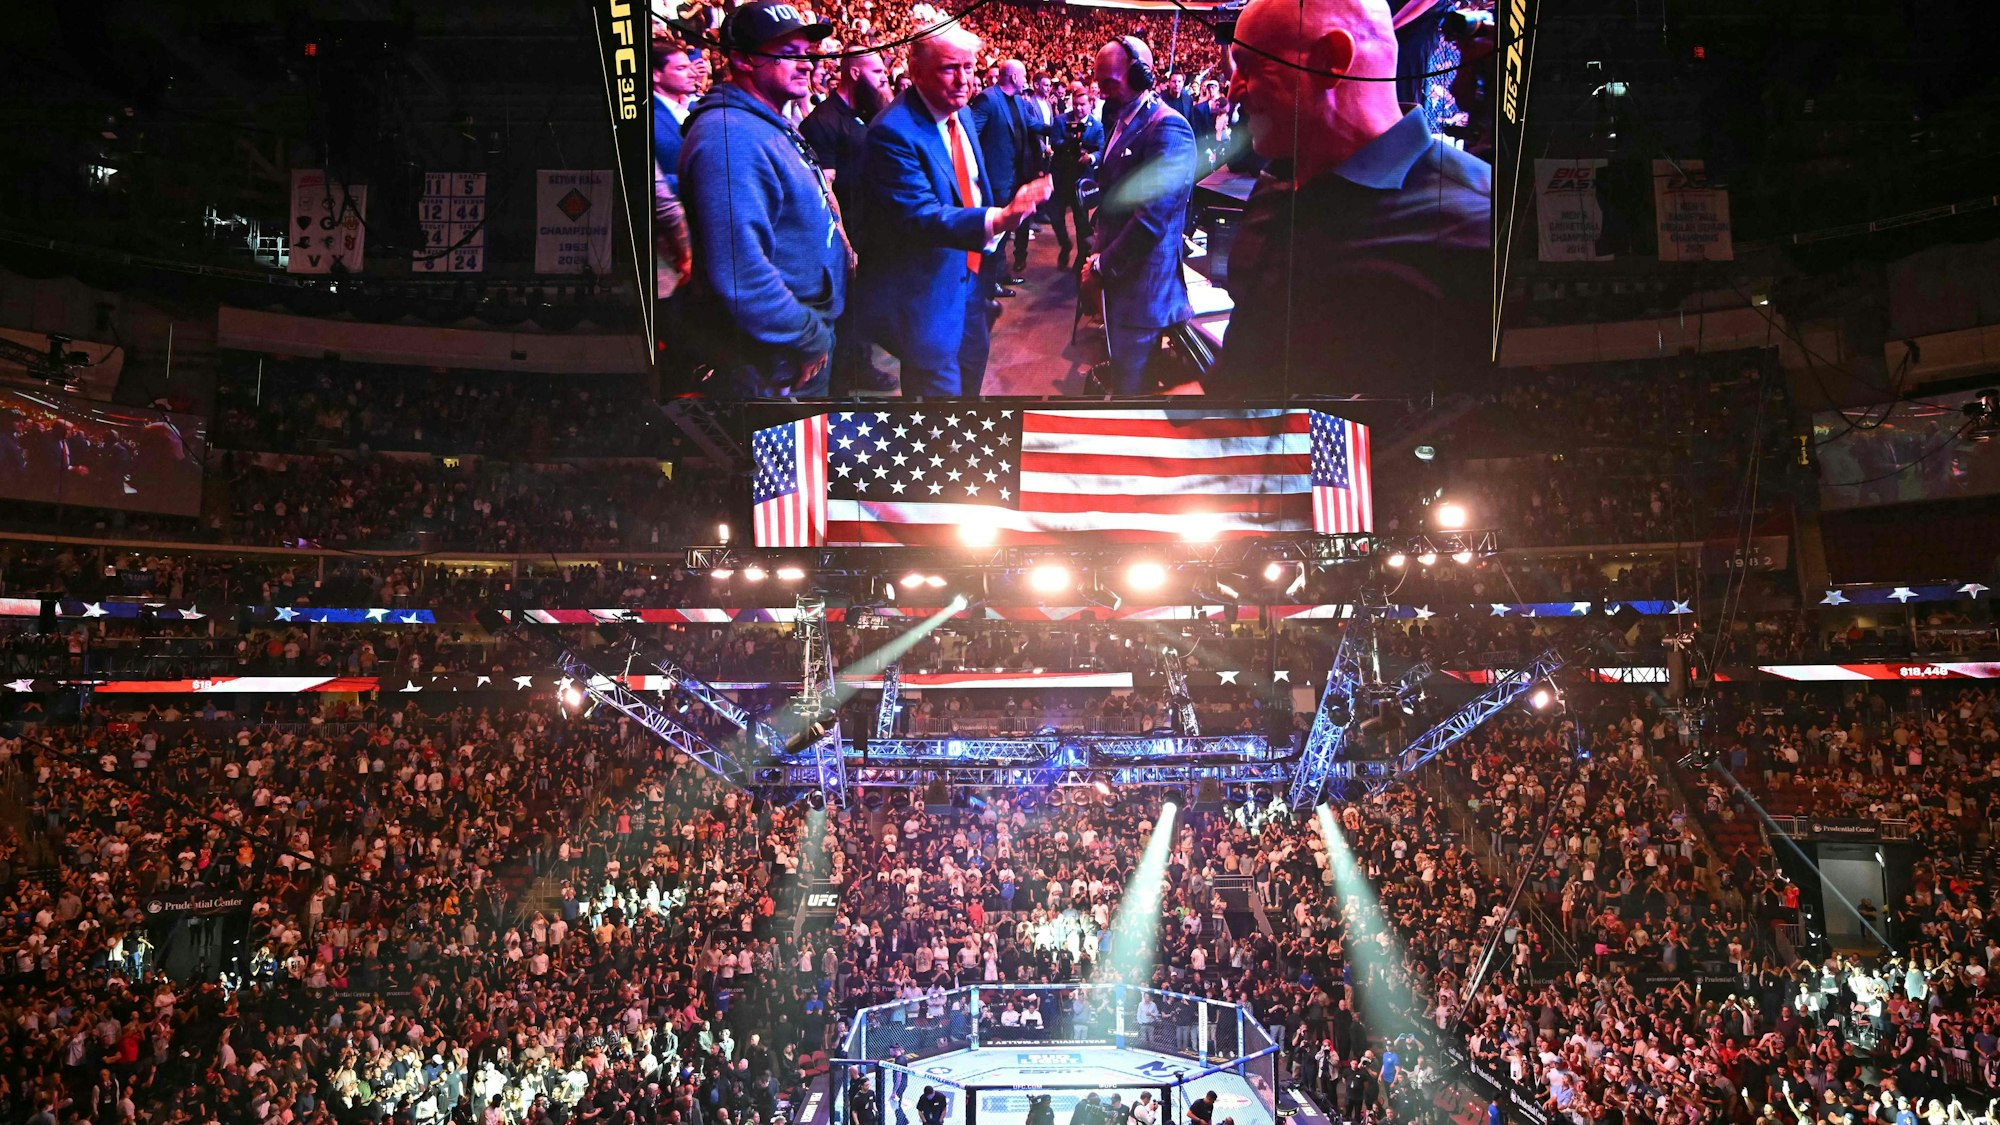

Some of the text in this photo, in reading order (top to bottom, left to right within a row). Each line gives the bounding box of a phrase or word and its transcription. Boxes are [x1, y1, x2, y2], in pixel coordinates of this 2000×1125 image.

[622, 78, 637, 120] 316
[1506, 75, 1518, 124] 316
[549, 175, 576, 184] SETON
[1553, 168, 1592, 178] BIG
[427, 180, 441, 194] 11
[464, 180, 473, 194] 5
[424, 205, 442, 219] 12
[457, 205, 478, 219] 44
[540, 227, 608, 236] CHAMPIONS
[559, 243, 588, 251] 1953
[455, 256, 476, 269] 24
[1735, 547, 1760, 555] ET
[807, 893, 838, 907] UFC
